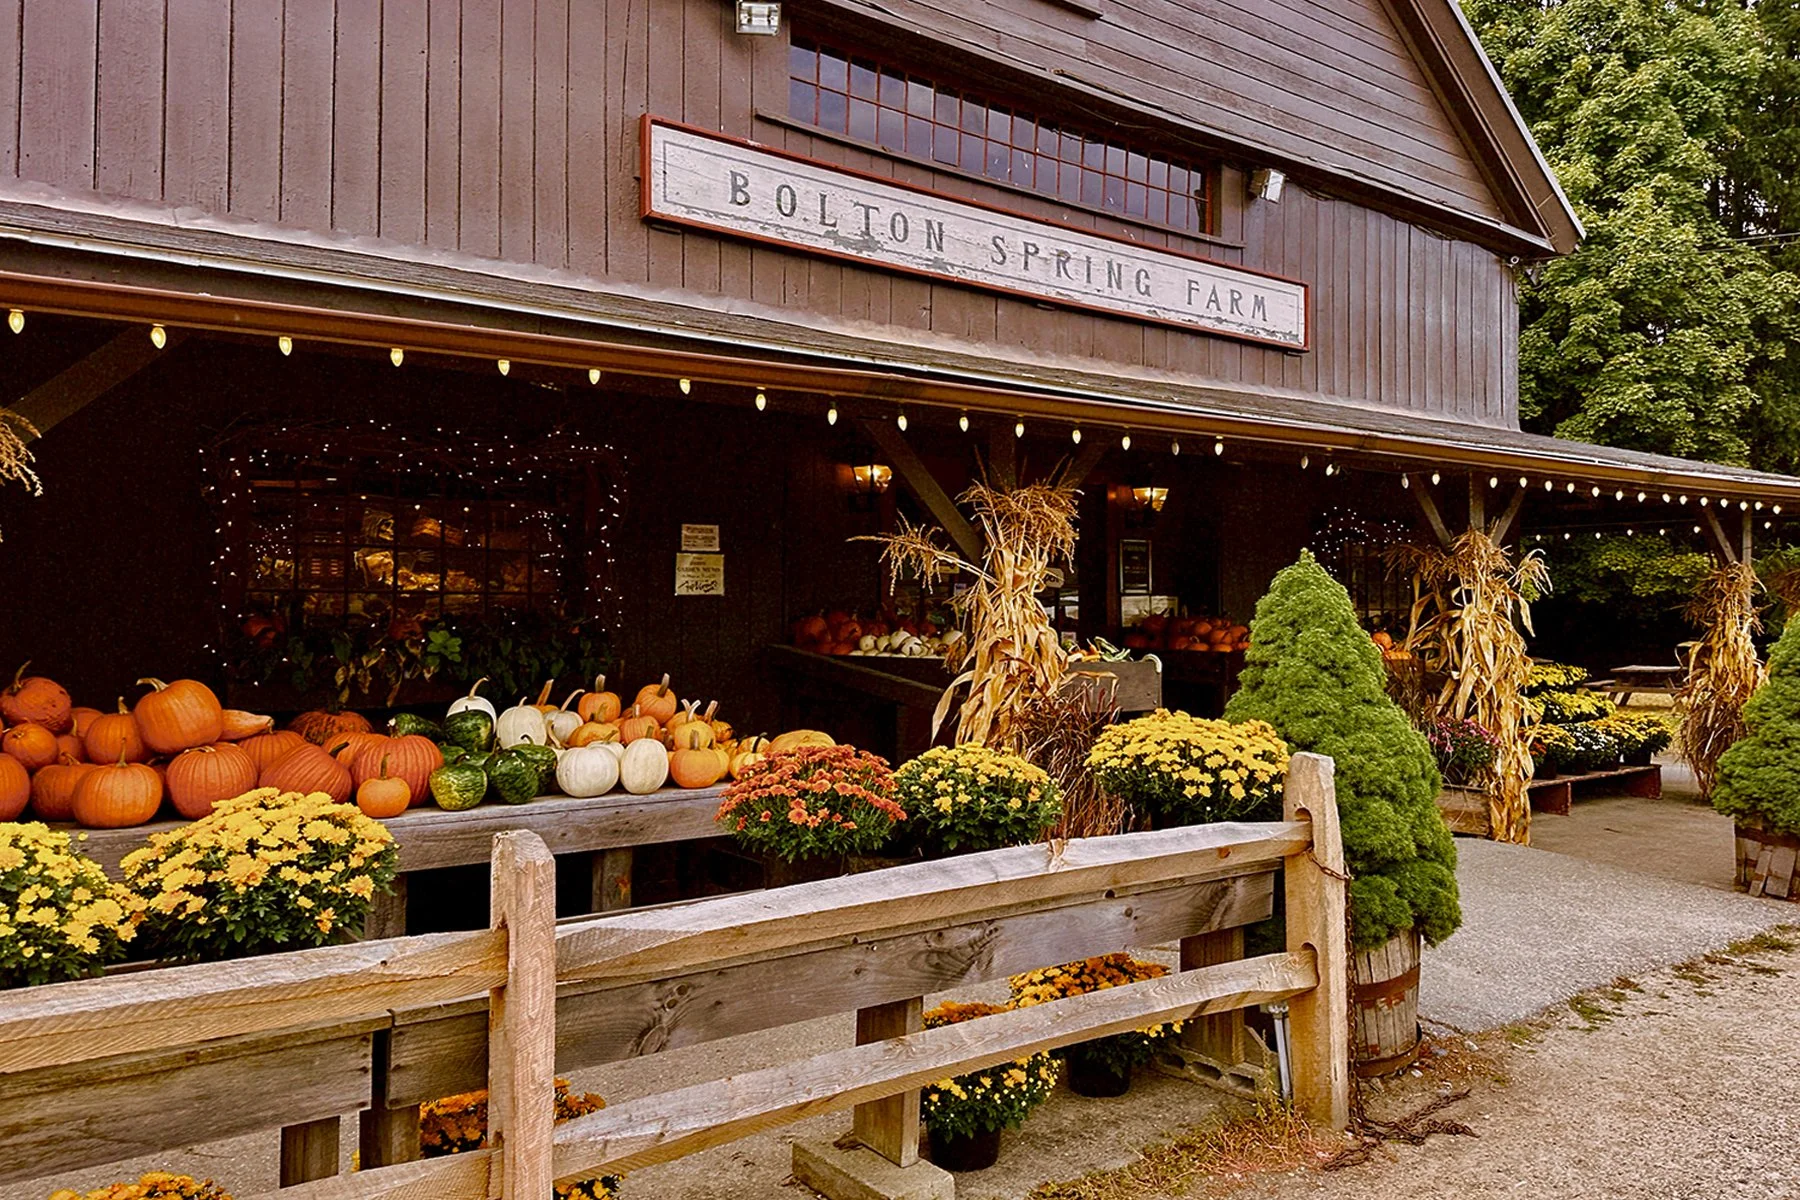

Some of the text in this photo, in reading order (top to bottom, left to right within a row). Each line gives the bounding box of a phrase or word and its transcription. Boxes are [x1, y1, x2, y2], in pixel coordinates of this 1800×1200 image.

[729, 170, 1268, 322] BOLTON SPRING FARM
